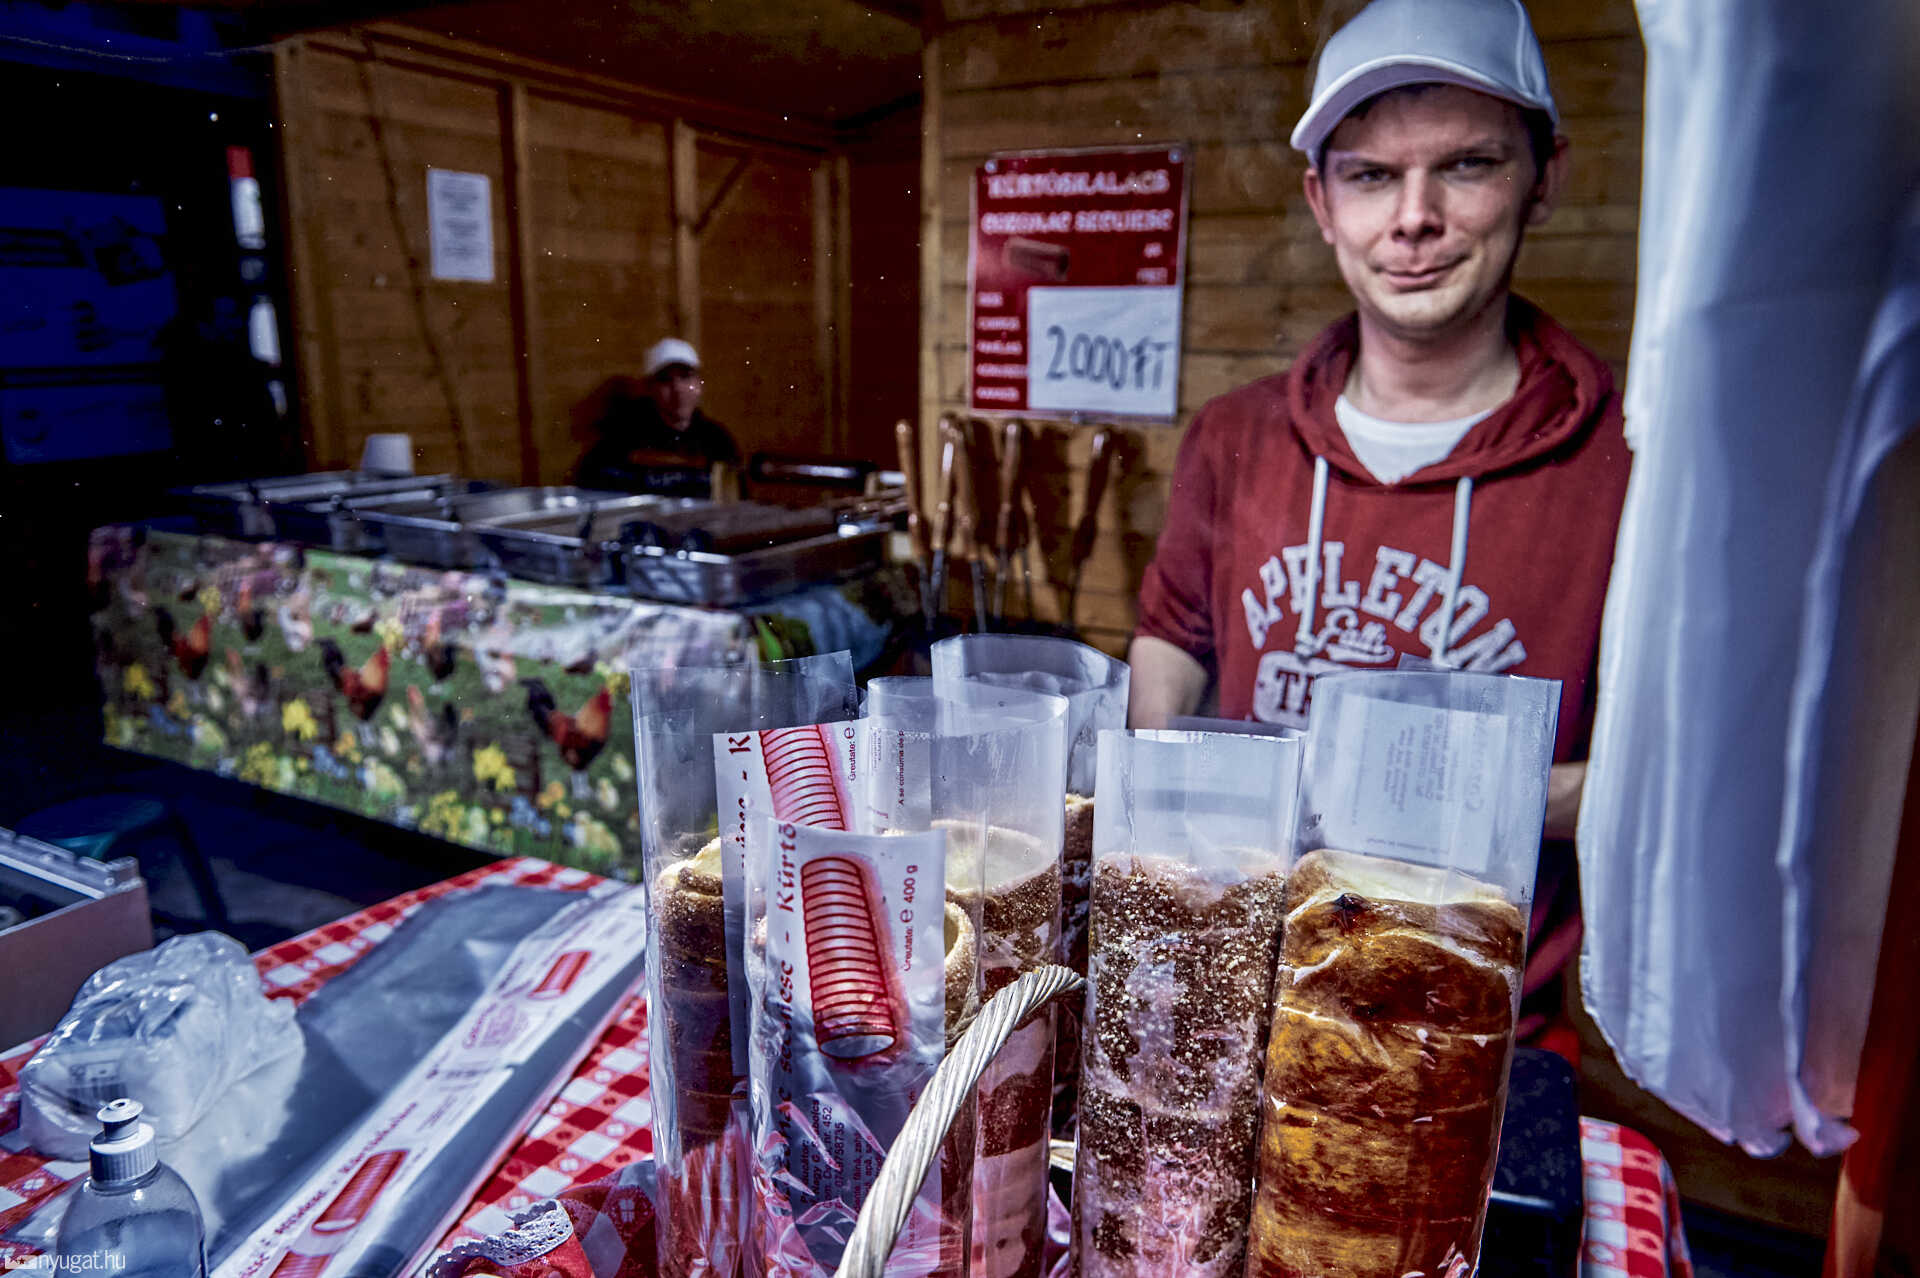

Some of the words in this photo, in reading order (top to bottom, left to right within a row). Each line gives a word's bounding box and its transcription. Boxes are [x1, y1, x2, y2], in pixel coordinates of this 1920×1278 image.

[1240, 541, 1528, 674] APPLETON
[906, 864, 919, 874] g
[904, 877, 916, 904] 400
[822, 1106, 833, 1127] 452
[811, 1166, 822, 1194] Nagy
